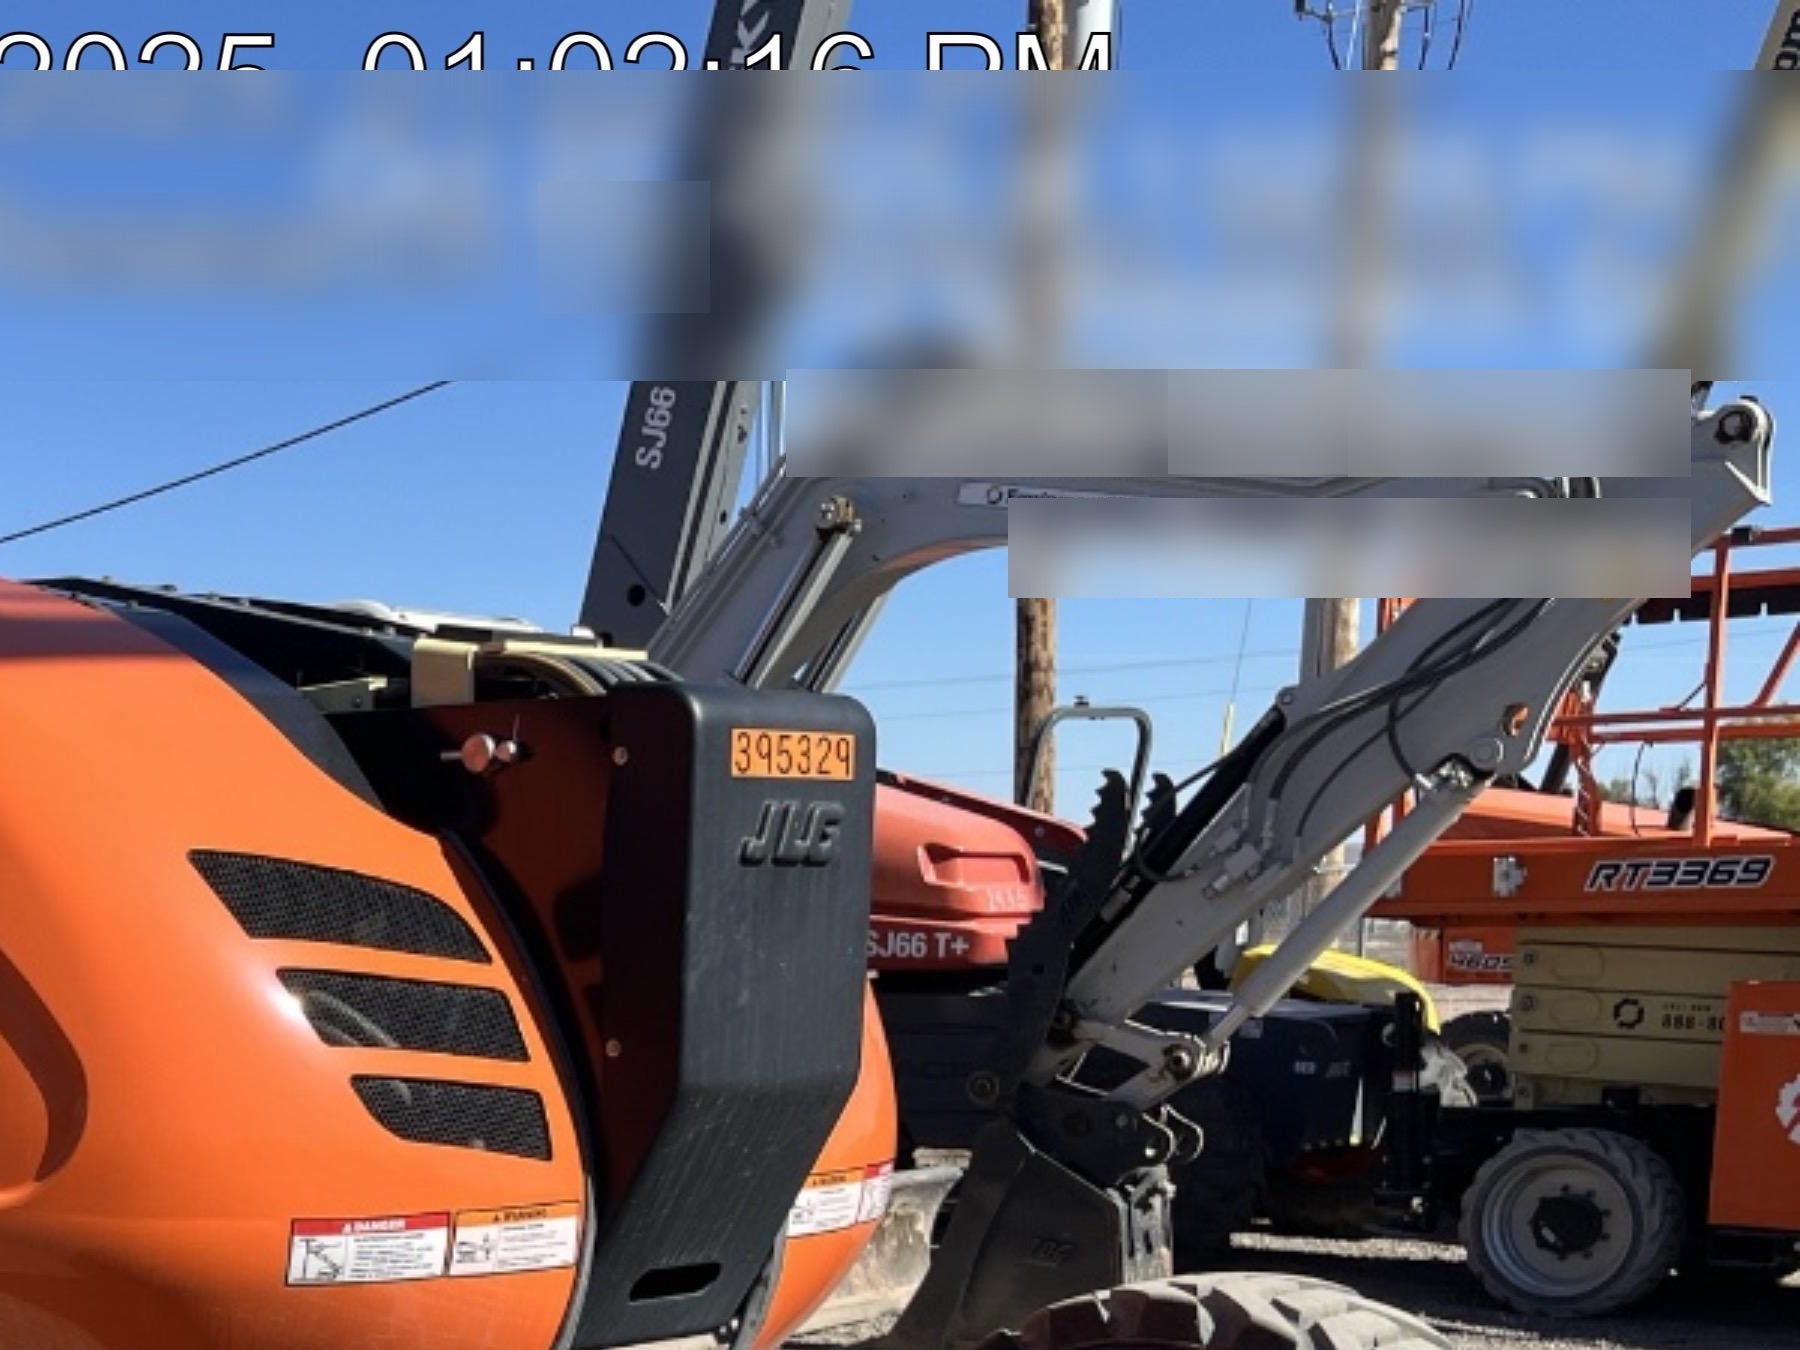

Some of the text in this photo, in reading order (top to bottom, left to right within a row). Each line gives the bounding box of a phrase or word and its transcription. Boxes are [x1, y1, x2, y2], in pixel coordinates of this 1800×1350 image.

[634, 386, 676, 470] SJ66
[735, 731, 851, 777] 395329
[739, 799, 846, 867] JLG
[1584, 854, 1776, 892] RT3369
[866, 930, 969, 958] SJ66 T+
